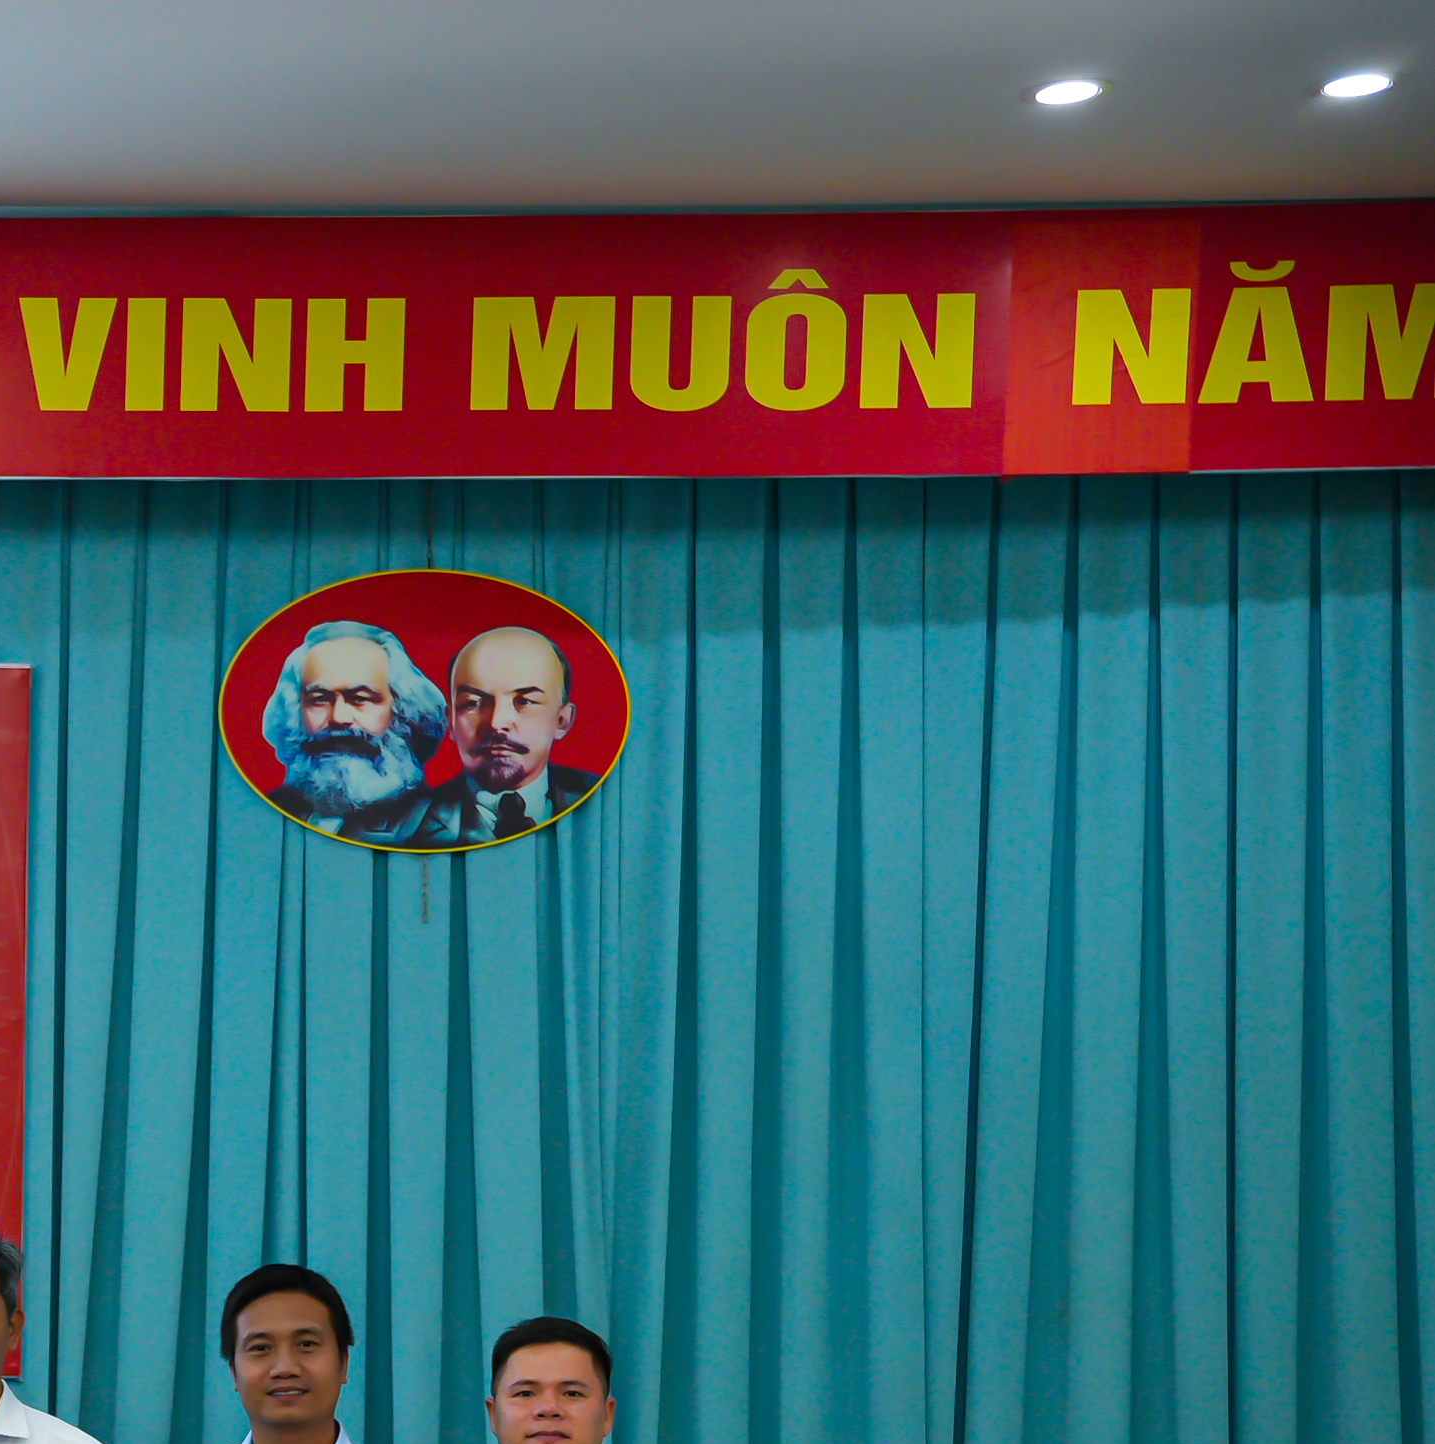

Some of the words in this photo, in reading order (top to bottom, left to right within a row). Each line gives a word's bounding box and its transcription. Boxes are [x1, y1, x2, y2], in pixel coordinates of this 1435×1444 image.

[19, 297, 406, 412] VINH
[470, 268, 976, 412] MUÔN
[1071, 260, 1435, 406] NĂM
